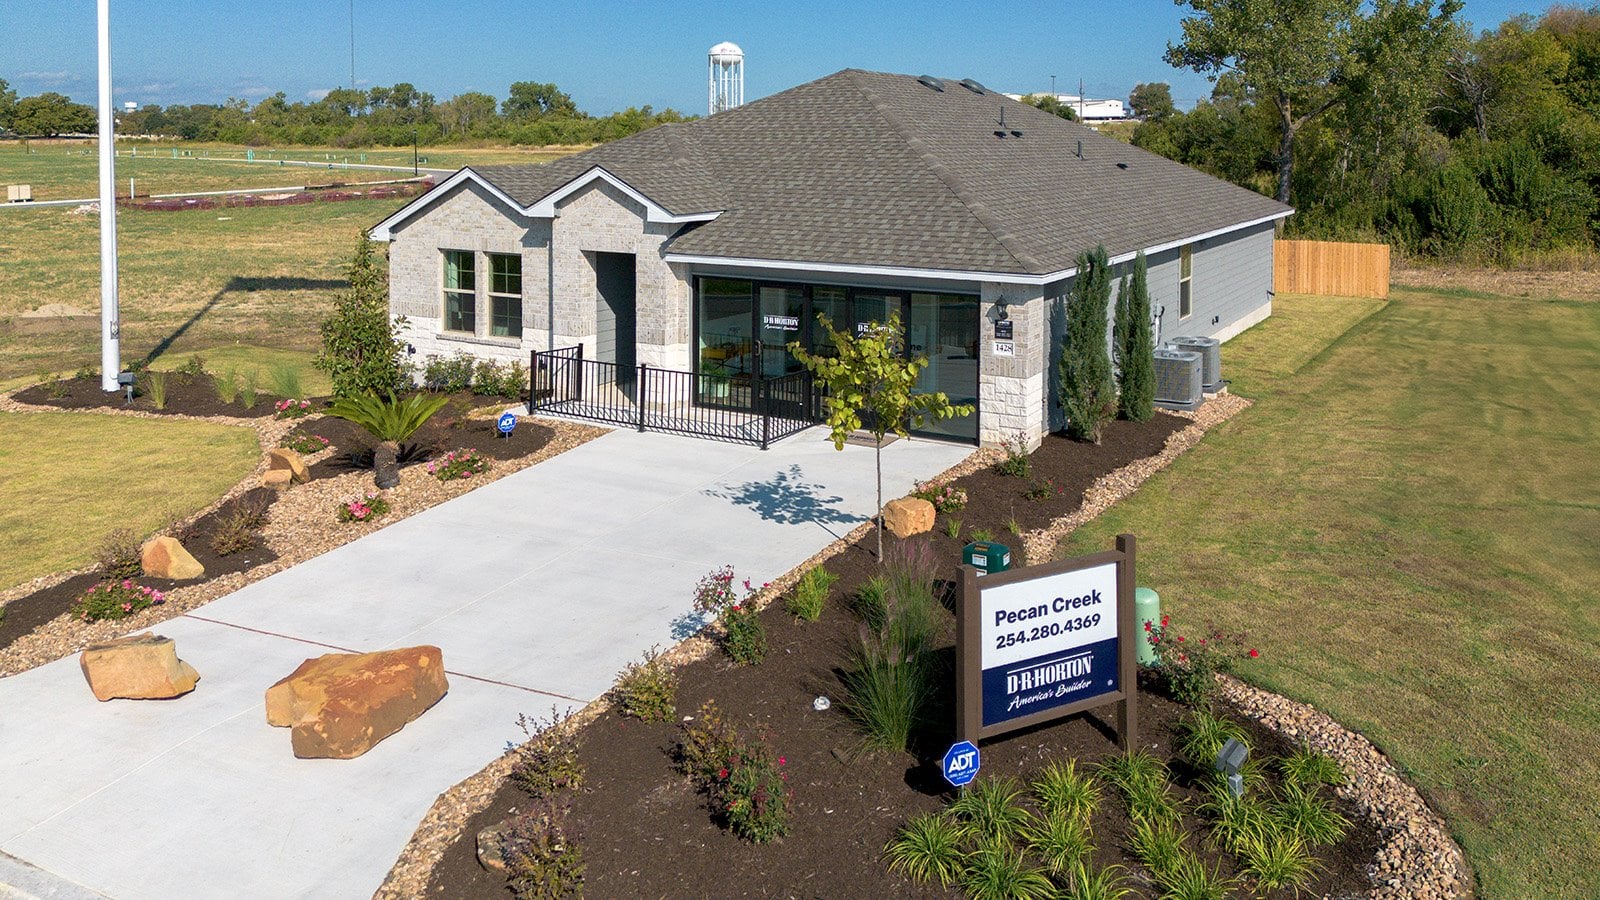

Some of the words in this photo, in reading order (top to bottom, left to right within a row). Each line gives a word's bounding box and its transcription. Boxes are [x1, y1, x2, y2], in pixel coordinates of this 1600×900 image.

[995, 604, 1048, 626] Pecan
[1052, 589, 1102, 613] Creek
[996, 613, 1101, 649] 254.280.4369
[1007, 689, 1054, 711] America's
[1055, 679, 1092, 697] Builder
[948, 751, 976, 773] ADT
